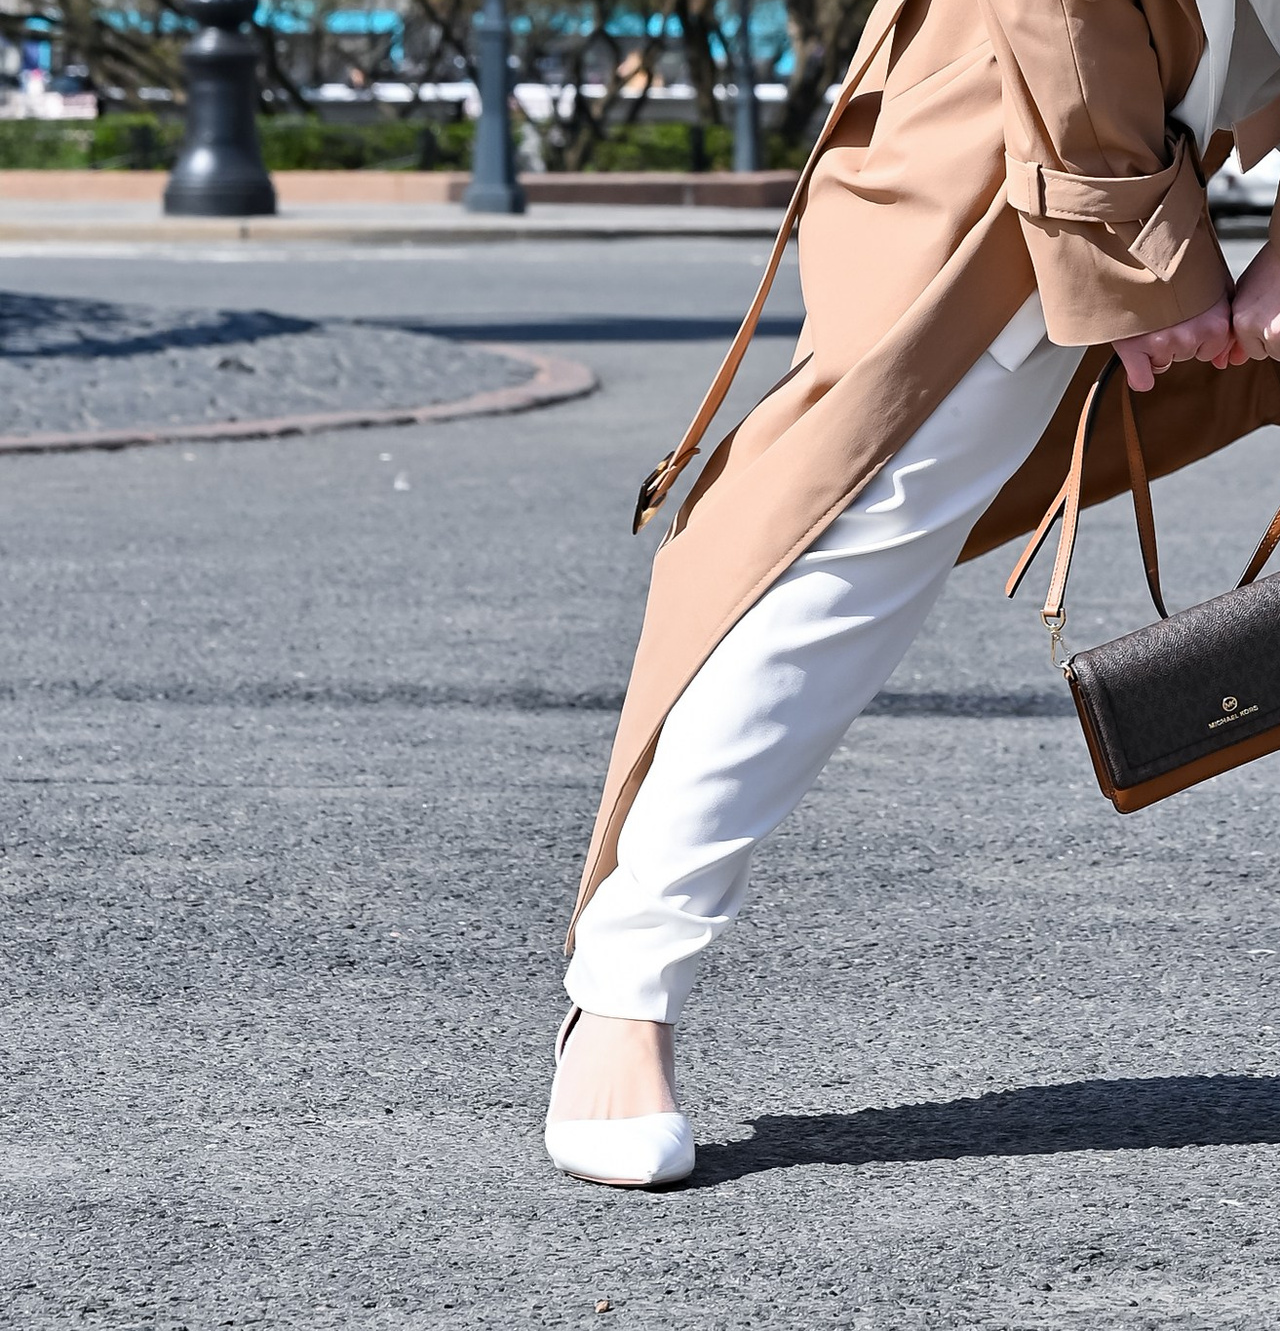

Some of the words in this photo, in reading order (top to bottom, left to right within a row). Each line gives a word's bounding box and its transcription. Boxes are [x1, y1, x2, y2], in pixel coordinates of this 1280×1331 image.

[1223, 698, 1237, 710] MK
[1208, 713, 1239, 729] MICHAEL
[1240, 704, 1259, 716] KORS
